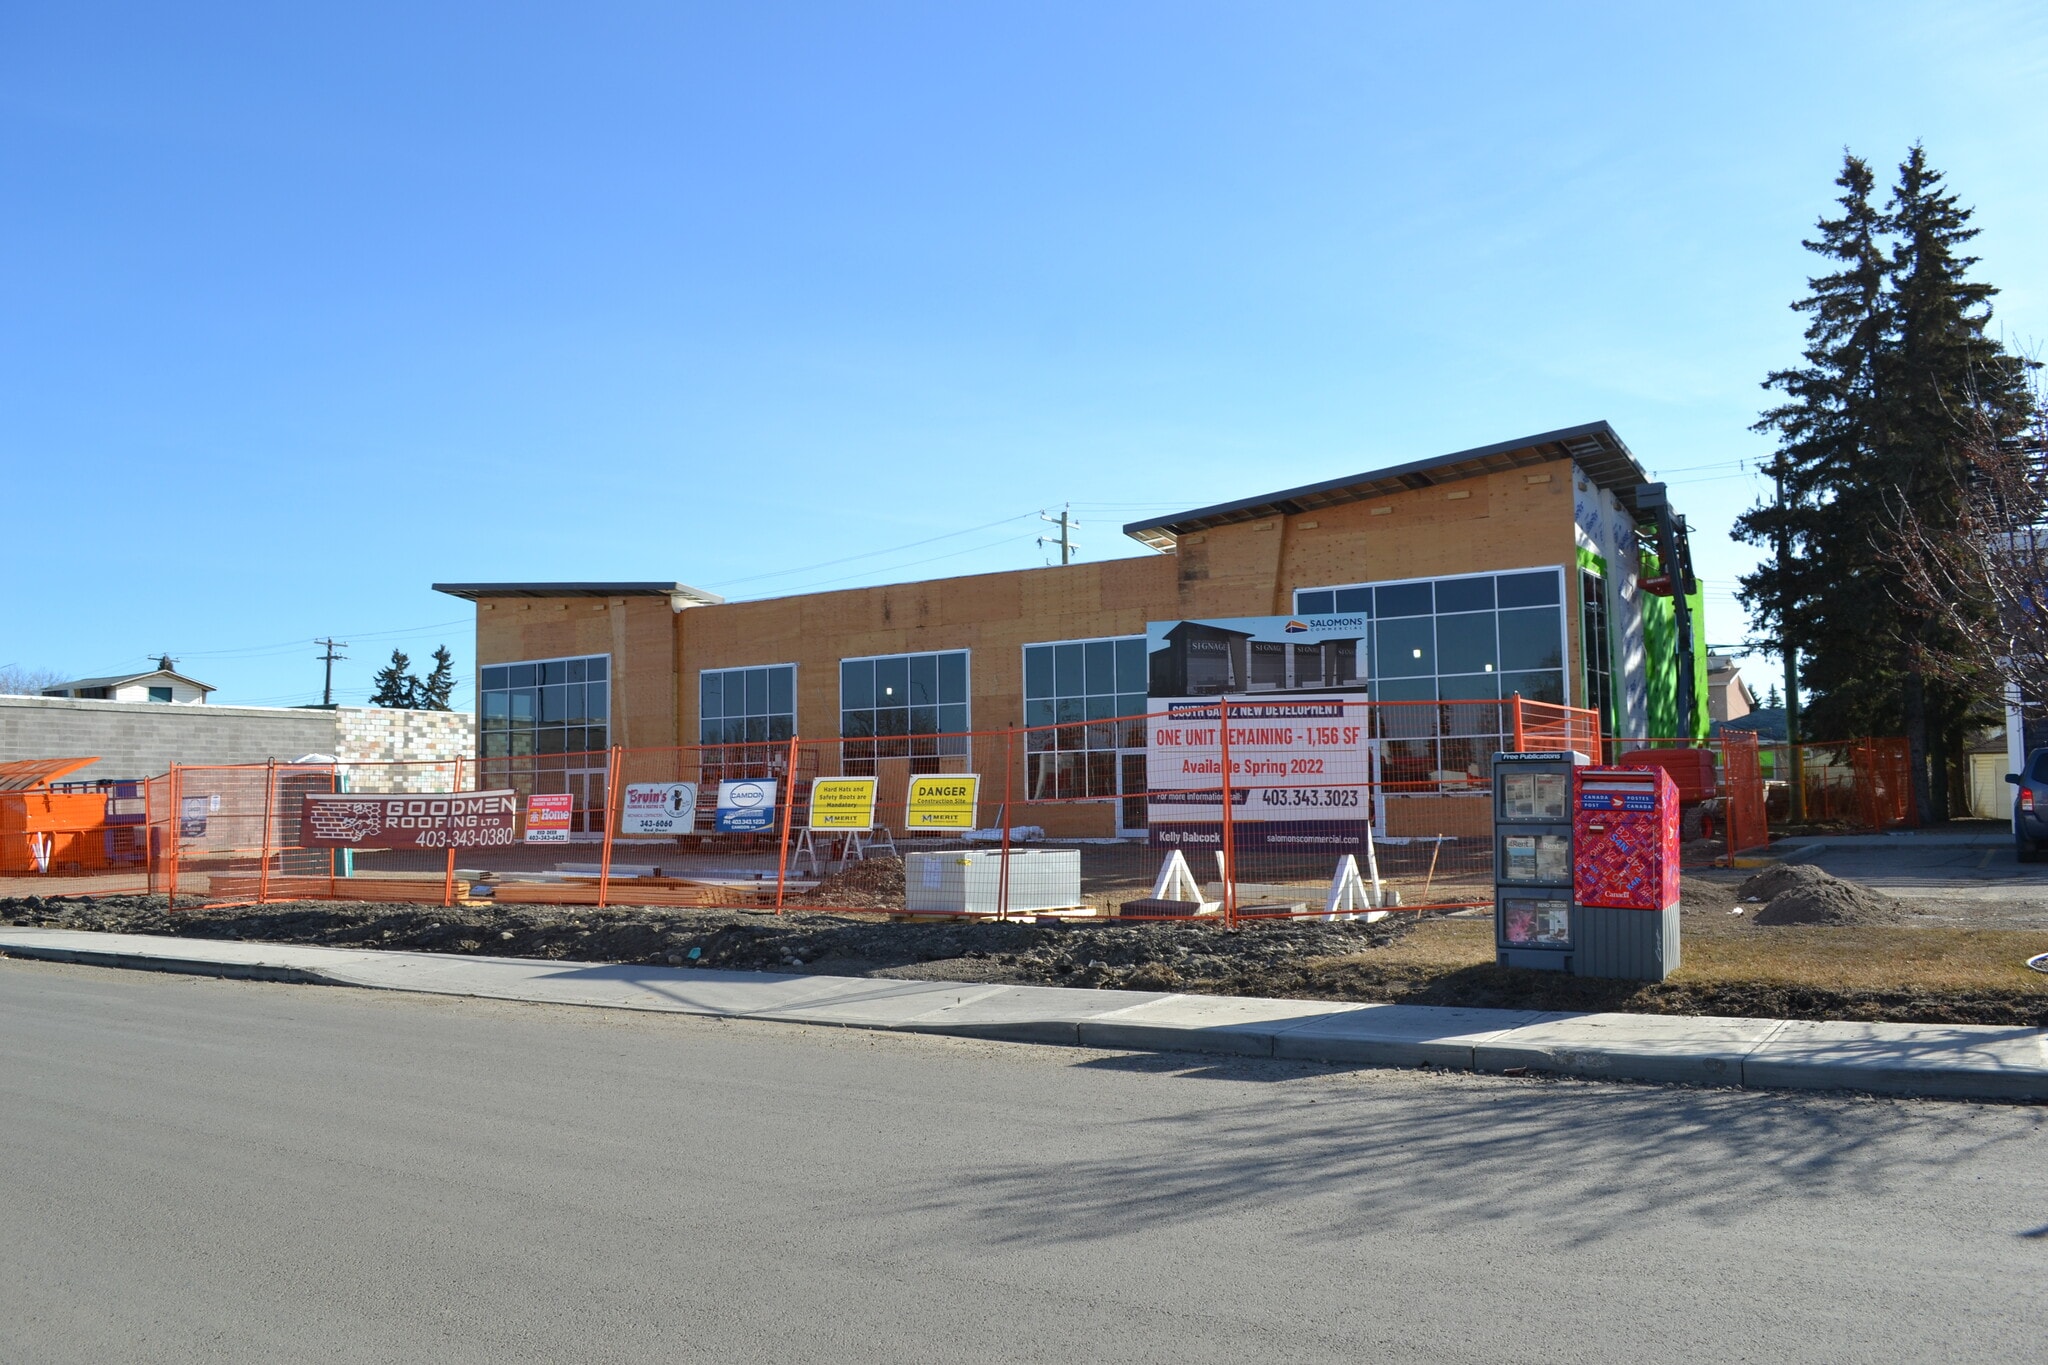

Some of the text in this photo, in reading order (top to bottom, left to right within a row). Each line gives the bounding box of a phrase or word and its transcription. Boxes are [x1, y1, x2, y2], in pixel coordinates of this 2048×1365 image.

[1310, 618, 1363, 628] SALOMONS
[1172, 704, 1338, 718] SOUTH GATZ NEW DEVELOPMENT
[1156, 729, 1182, 746] ONE
[1186, 728, 1216, 746] UNIT
[1306, 728, 1338, 746] 1,156
[1343, 726, 1360, 744] SF
[1182, 758, 1324, 777] Availale Spring 2022
[628, 788, 667, 804] Bruin's
[919, 787, 966, 796] DANGER
[1262, 789, 1358, 806] 403.343.3023
[386, 796, 516, 816] GOODMEN
[542, 808, 569, 820] Home
[386, 816, 500, 828] ROOFING LTD
[415, 827, 513, 848] 403-343-0380
[1159, 831, 1220, 844] Kelly Babcock
[1267, 834, 1360, 844] salomonscommercial.com
[1610, 834, 1629, 852] S4N
[1616, 826, 1636, 846] B2Z
